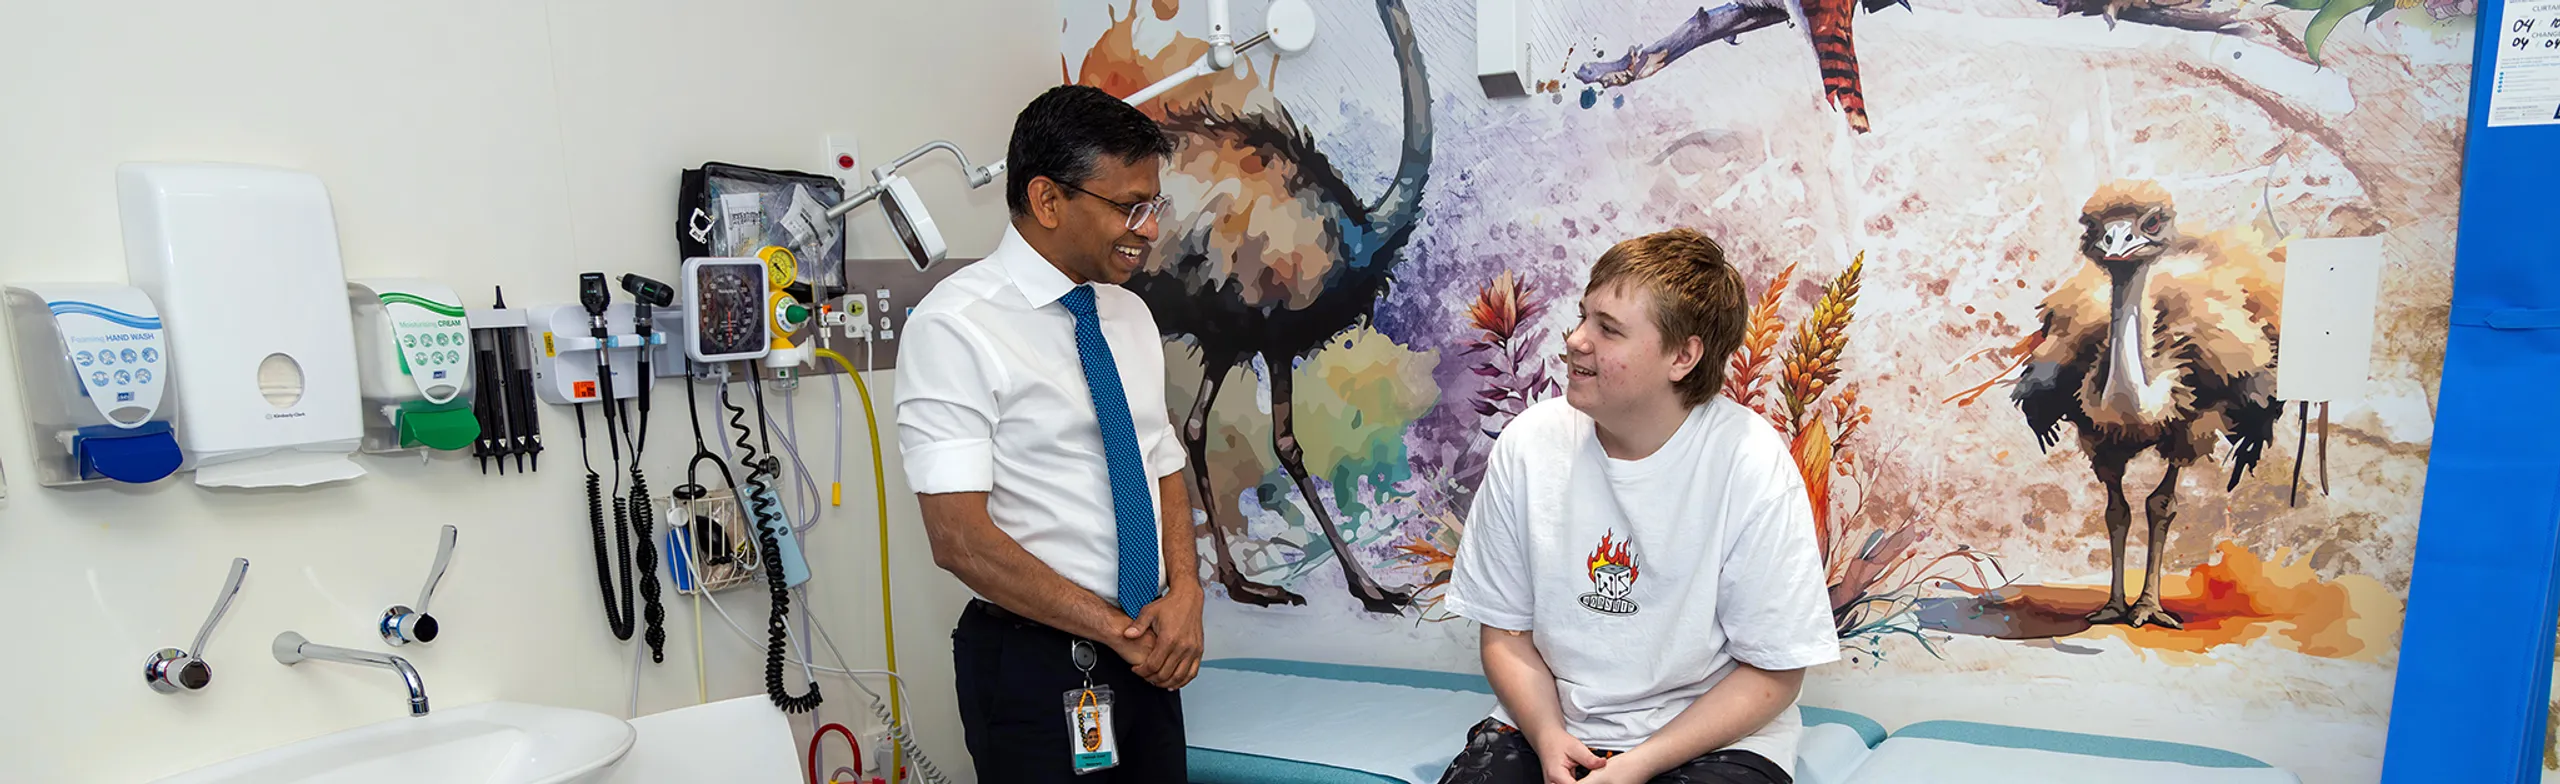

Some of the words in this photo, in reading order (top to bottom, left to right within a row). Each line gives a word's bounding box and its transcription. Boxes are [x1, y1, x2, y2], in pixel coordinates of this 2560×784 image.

[2532, 4, 2560, 12] CURTAI
[2513, 18, 2535, 33] 04
[2512, 37, 2529, 51] 04
[438, 319, 461, 328] CREAM
[106, 333, 129, 342] HAND
[130, 332, 155, 341] WASH
